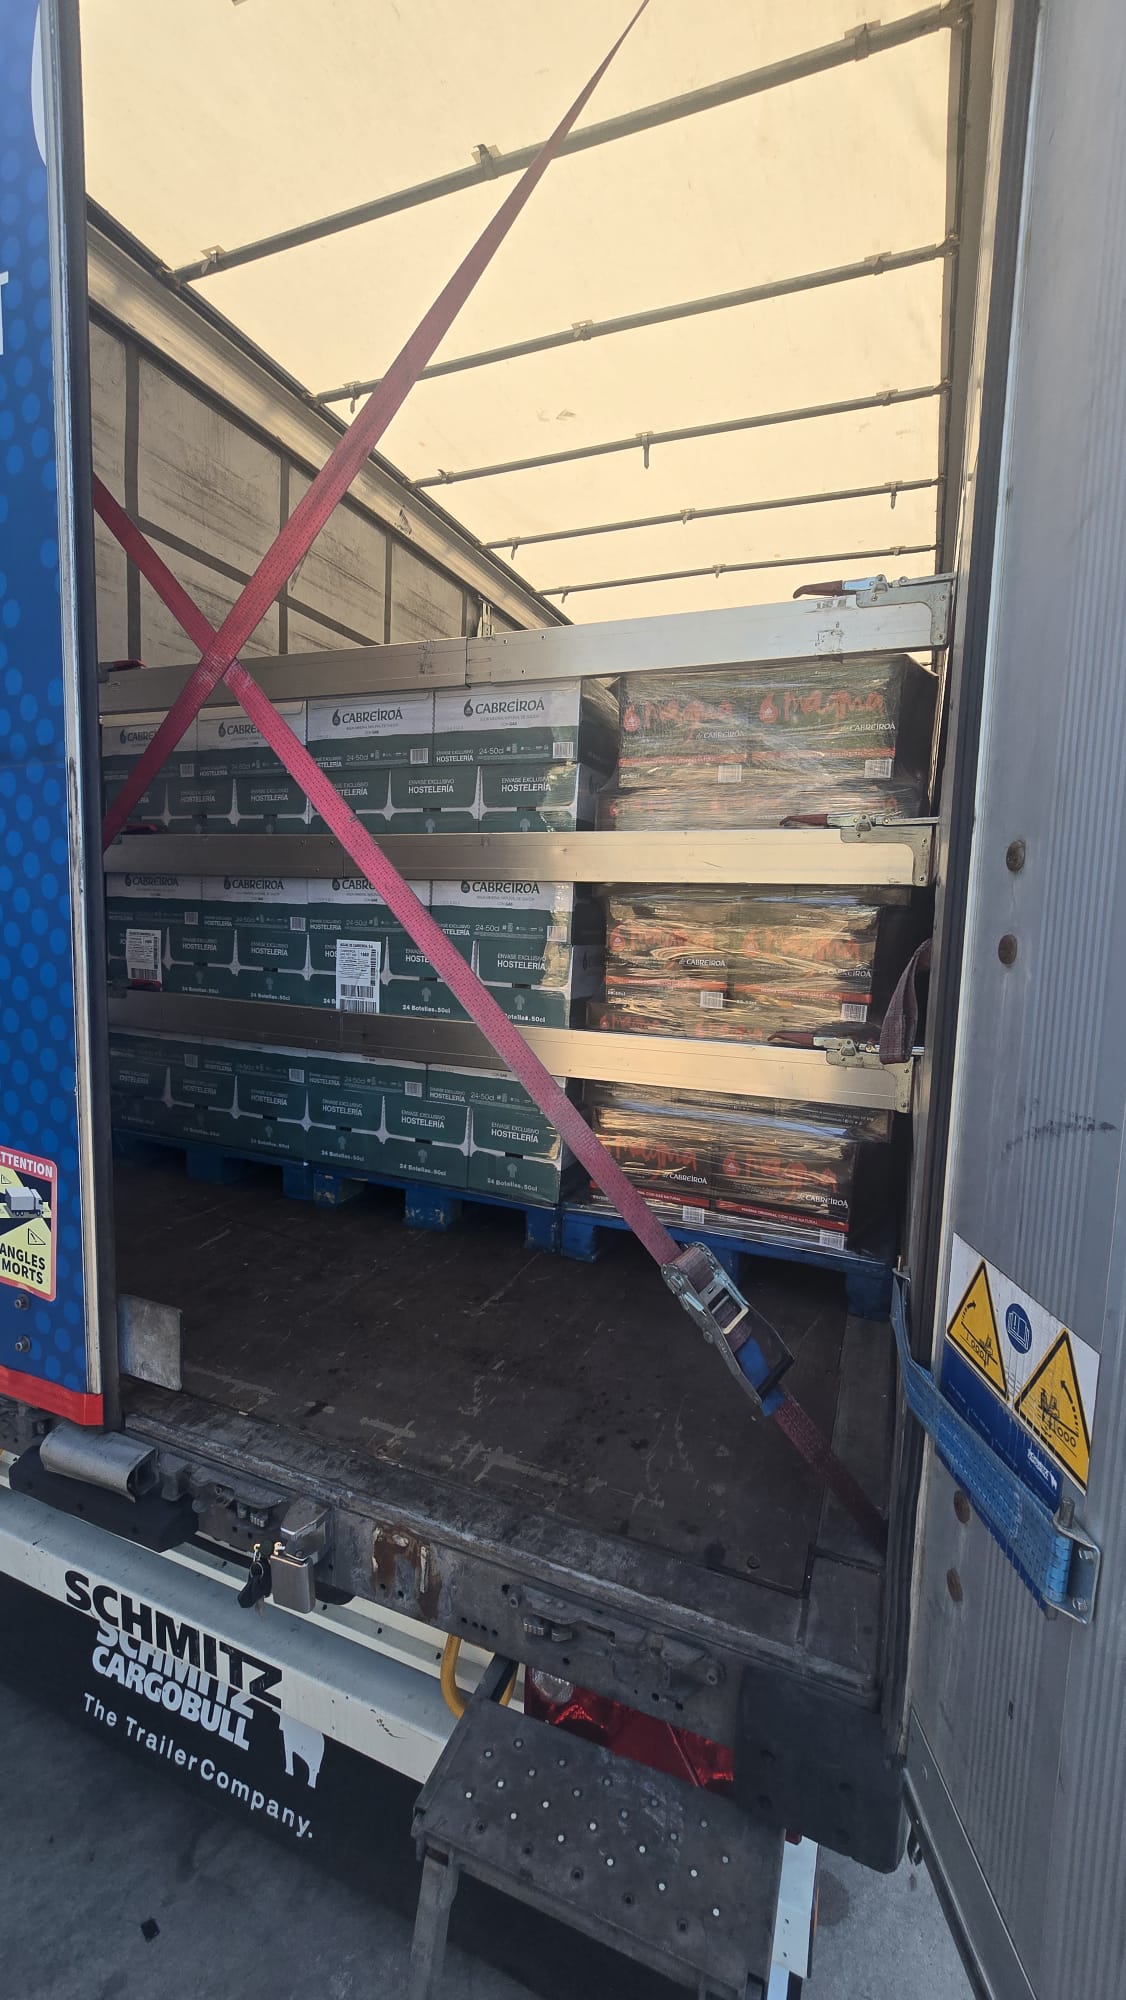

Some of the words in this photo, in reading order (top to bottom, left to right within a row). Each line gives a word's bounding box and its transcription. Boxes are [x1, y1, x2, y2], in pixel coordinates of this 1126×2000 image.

[476, 698, 545, 714] CABREIROÁ
[343, 707, 403, 723] CABREIROÁ
[437, 754, 473, 763] HOSTELERÍA
[409, 785, 454, 795] HOSTELERÍA
[502, 783, 551, 792] HOSTELERÍA
[497, 959, 547, 970] HOSTELERÍA
[430, 1092, 466, 1103] HOSTELERÍA
[323, 1105, 362, 1116] HOSTELERÍA
[402, 1115, 444, 1129] HOSTELERÍA
[492, 1128, 539, 1143] HOSTELERÍA
[2, 1258, 44, 1285] MORTS
[65, 1570, 283, 1710] SCHMITZ
[92, 1645, 254, 1751] CARGOBULL
[84, 1693, 119, 1728] The
